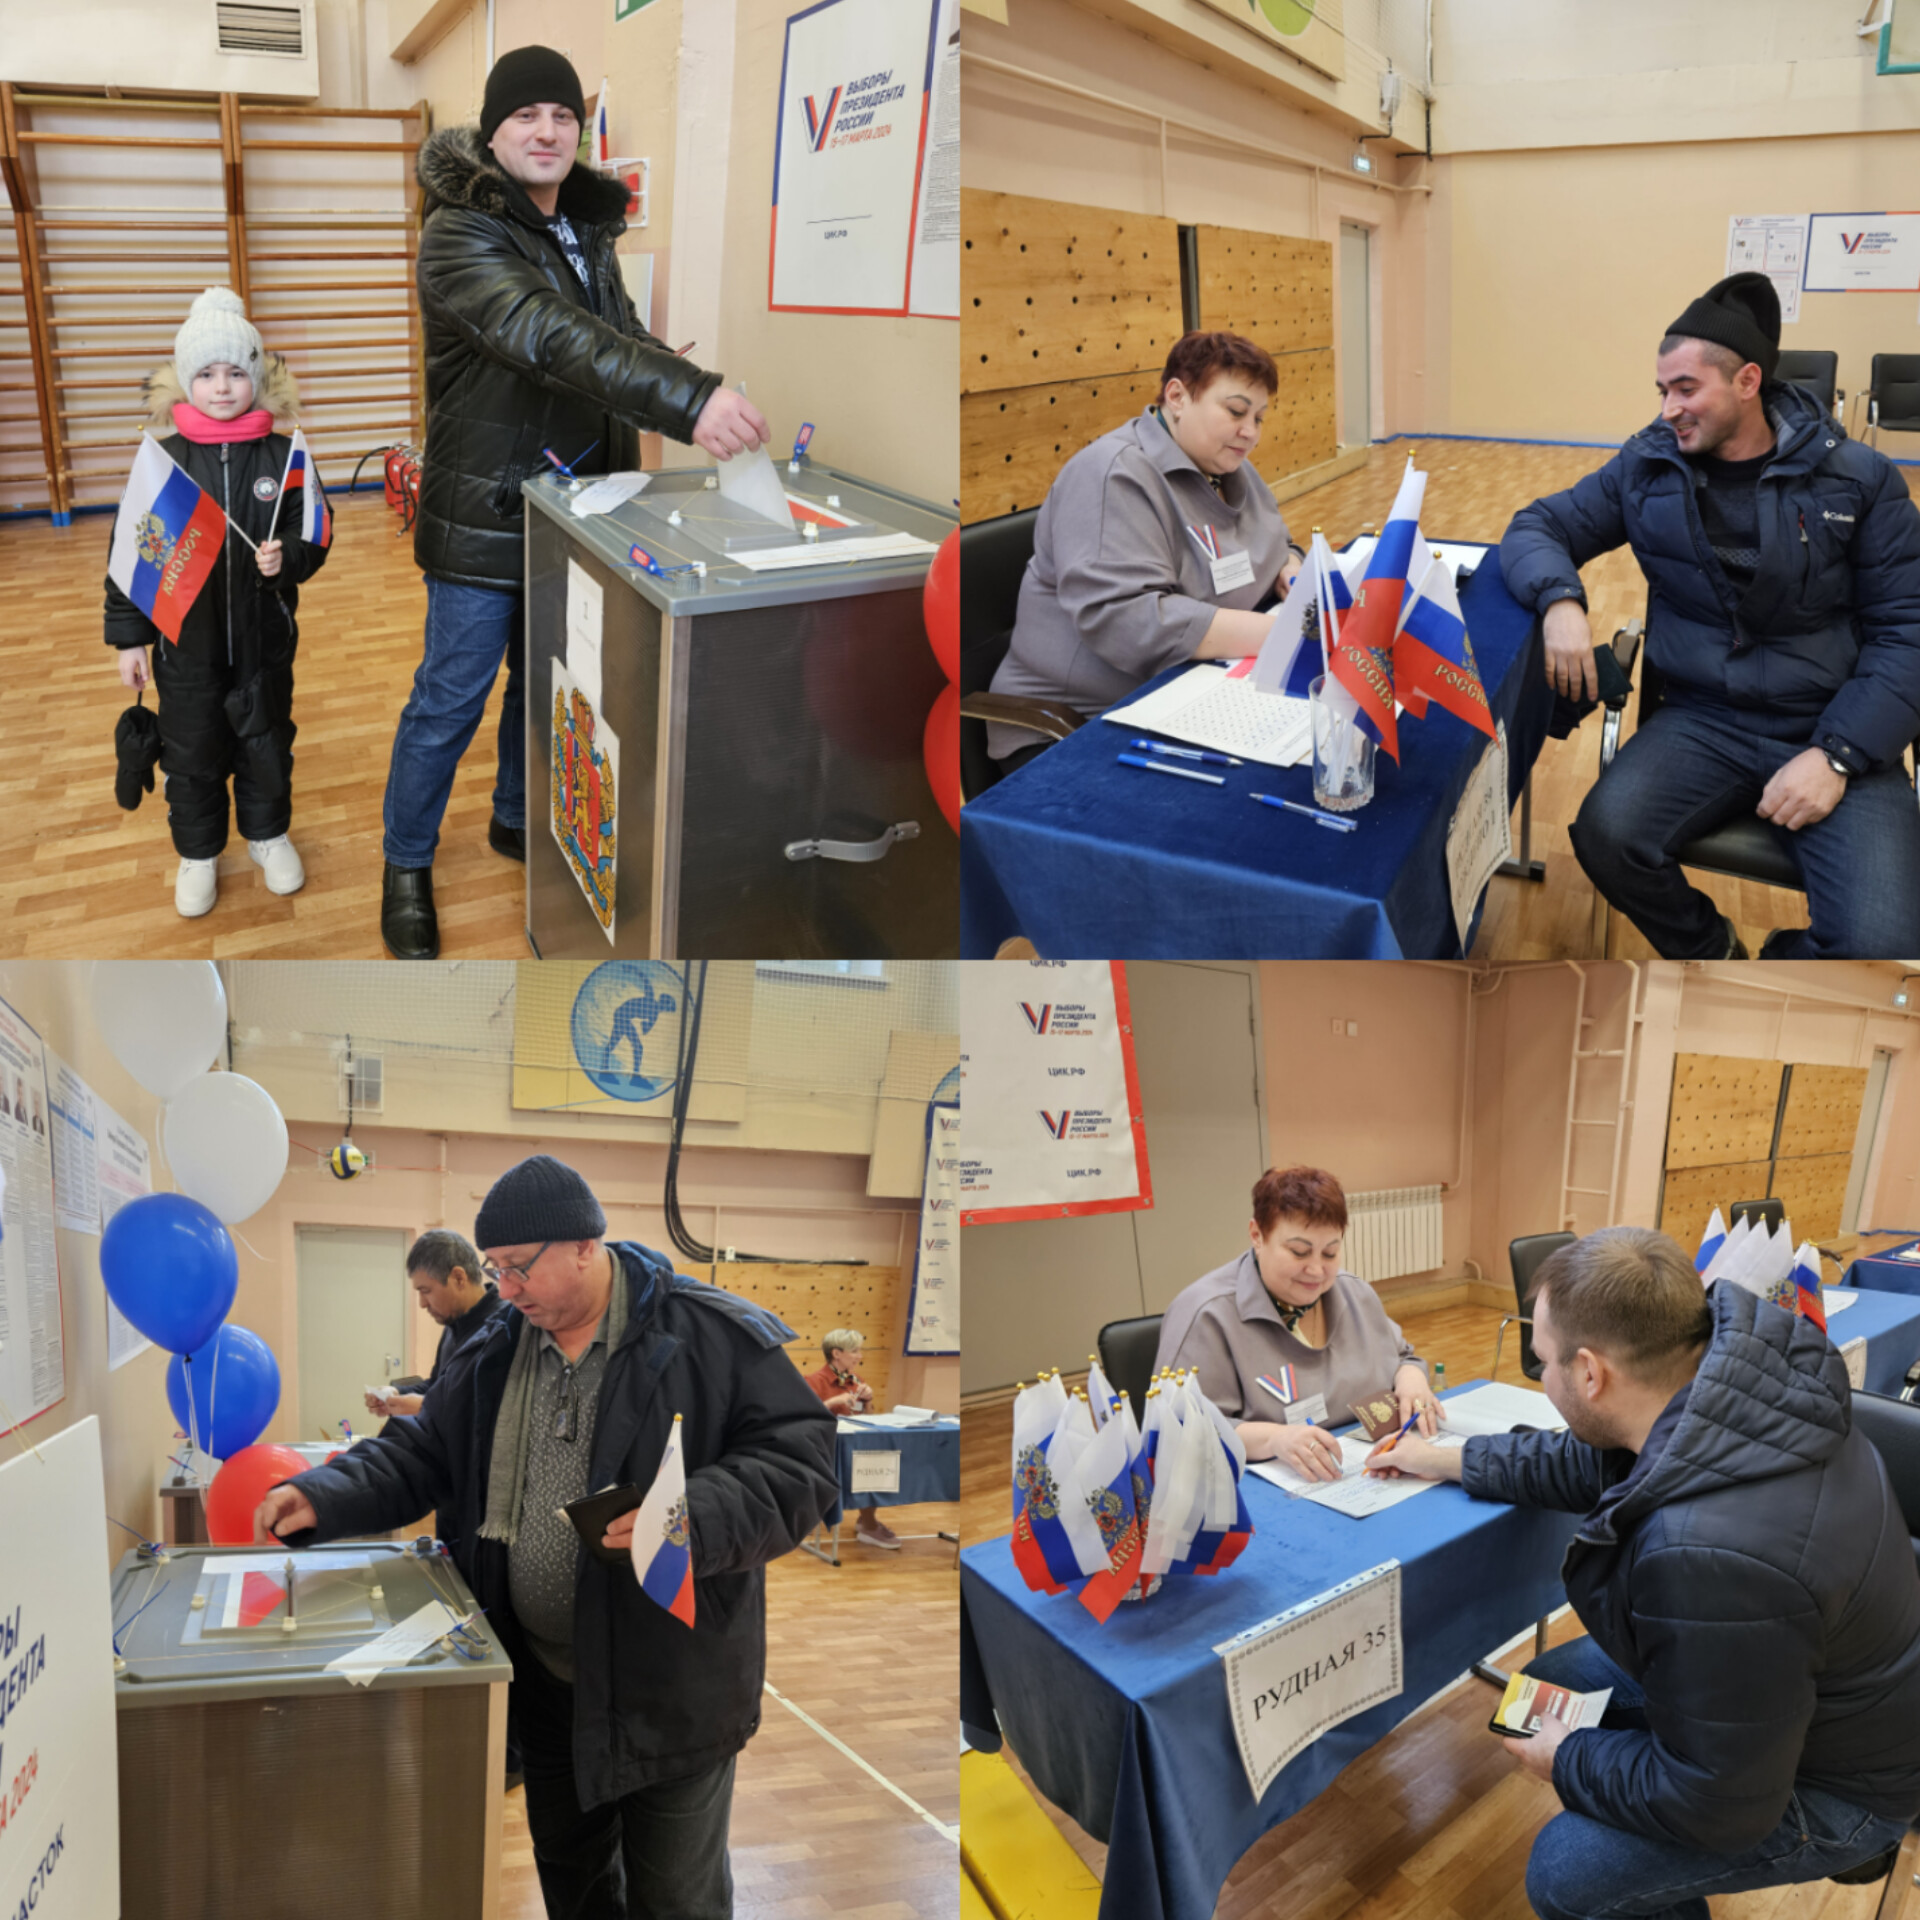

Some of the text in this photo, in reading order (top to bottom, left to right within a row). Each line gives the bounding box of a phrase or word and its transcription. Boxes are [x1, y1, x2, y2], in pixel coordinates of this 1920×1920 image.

[846, 69, 893, 95] ВЫБОРЫ
[840, 84, 905, 114] ПРЕЗИДЕНТА
[834, 111, 874, 133] РОССИИ
[849, 128, 873, 143] МАРТА
[824, 229, 848, 239] ЦИК.РФ
[1048, 1066, 1086, 1077] ЦИК.РФ
[1066, 1168, 1102, 1178] ЦИК.РФ
[1253, 1624, 1387, 1722] РУДНАЯ 35
[10, 1748, 38, 1820] 2024
[12, 1822, 64, 1920] АСТОК
